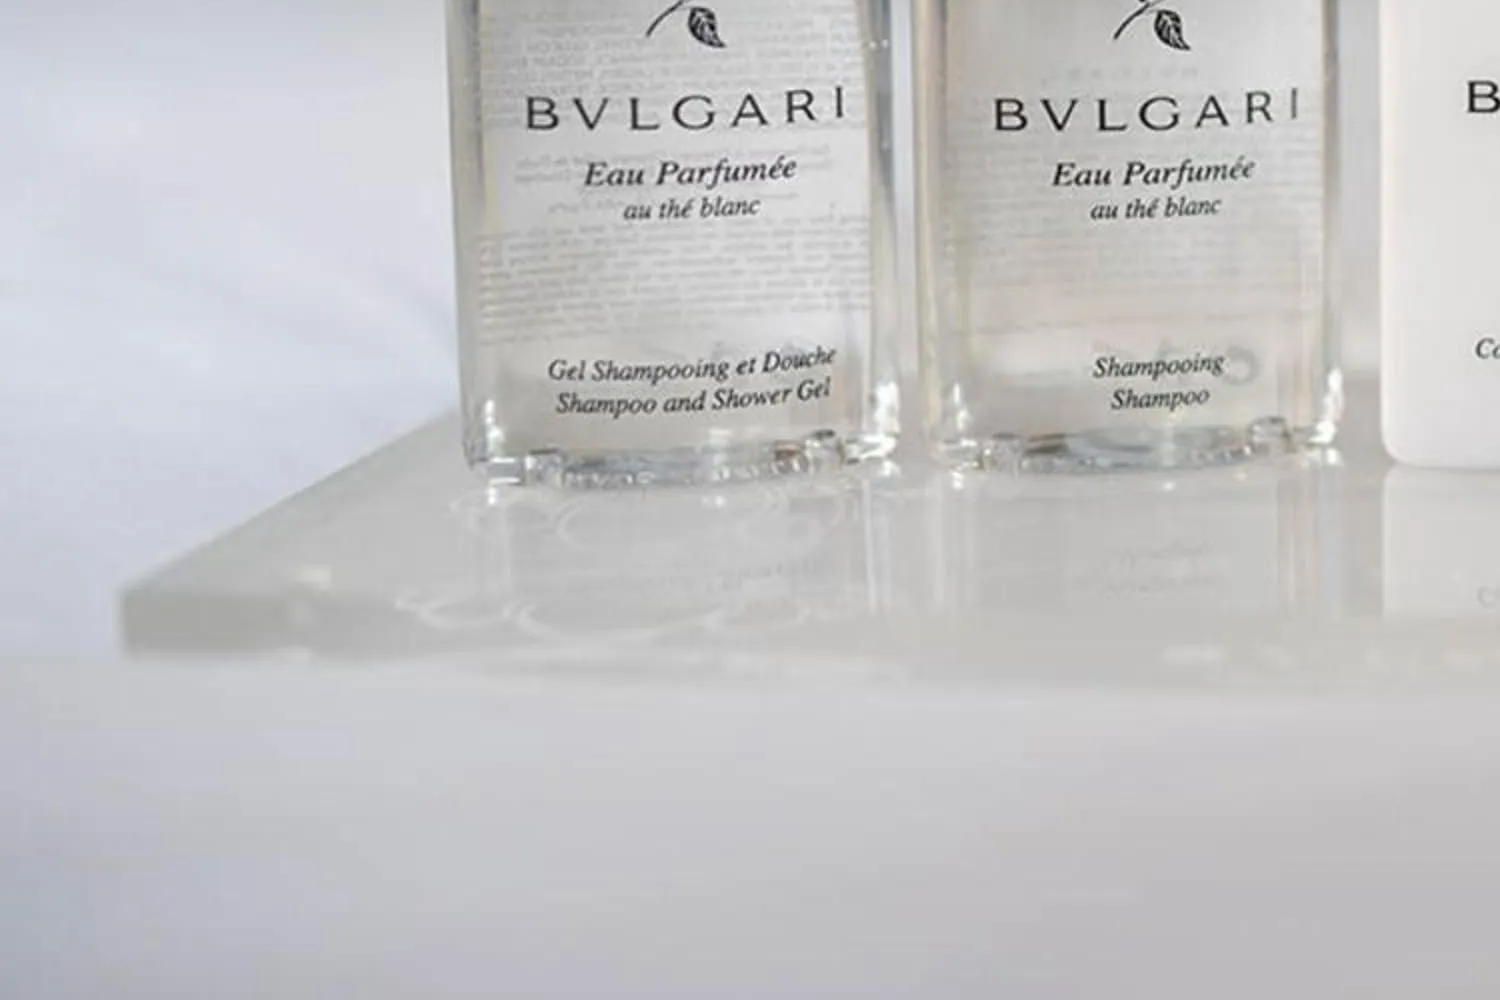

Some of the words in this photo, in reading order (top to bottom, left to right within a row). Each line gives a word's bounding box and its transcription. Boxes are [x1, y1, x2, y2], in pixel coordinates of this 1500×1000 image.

[525, 84, 845, 132] BVLGARI
[994, 87, 1299, 133] BVLGARI
[583, 160, 646, 188] Eau
[655, 154, 798, 191] Parfumée
[1051, 161, 1112, 188] Eau
[1122, 154, 1257, 191] Parfumée
[622, 204, 653, 221] au
[657, 197, 695, 220] thé
[699, 195, 762, 219] blanc
[1089, 204, 1119, 222] au
[1124, 197, 1161, 220] thé
[1163, 195, 1223, 219] blanc
[547, 359, 587, 381] Gel
[591, 358, 730, 387] Shampooing
[735, 357, 757, 376] et
[761, 345, 838, 374] Douche
[1092, 352, 1226, 382] Shampooing
[555, 391, 658, 421] Shampoo
[662, 389, 707, 413] and
[710, 387, 793, 411] Shower
[796, 375, 831, 402] Gel
[1110, 388, 1211, 413] Shampoo
